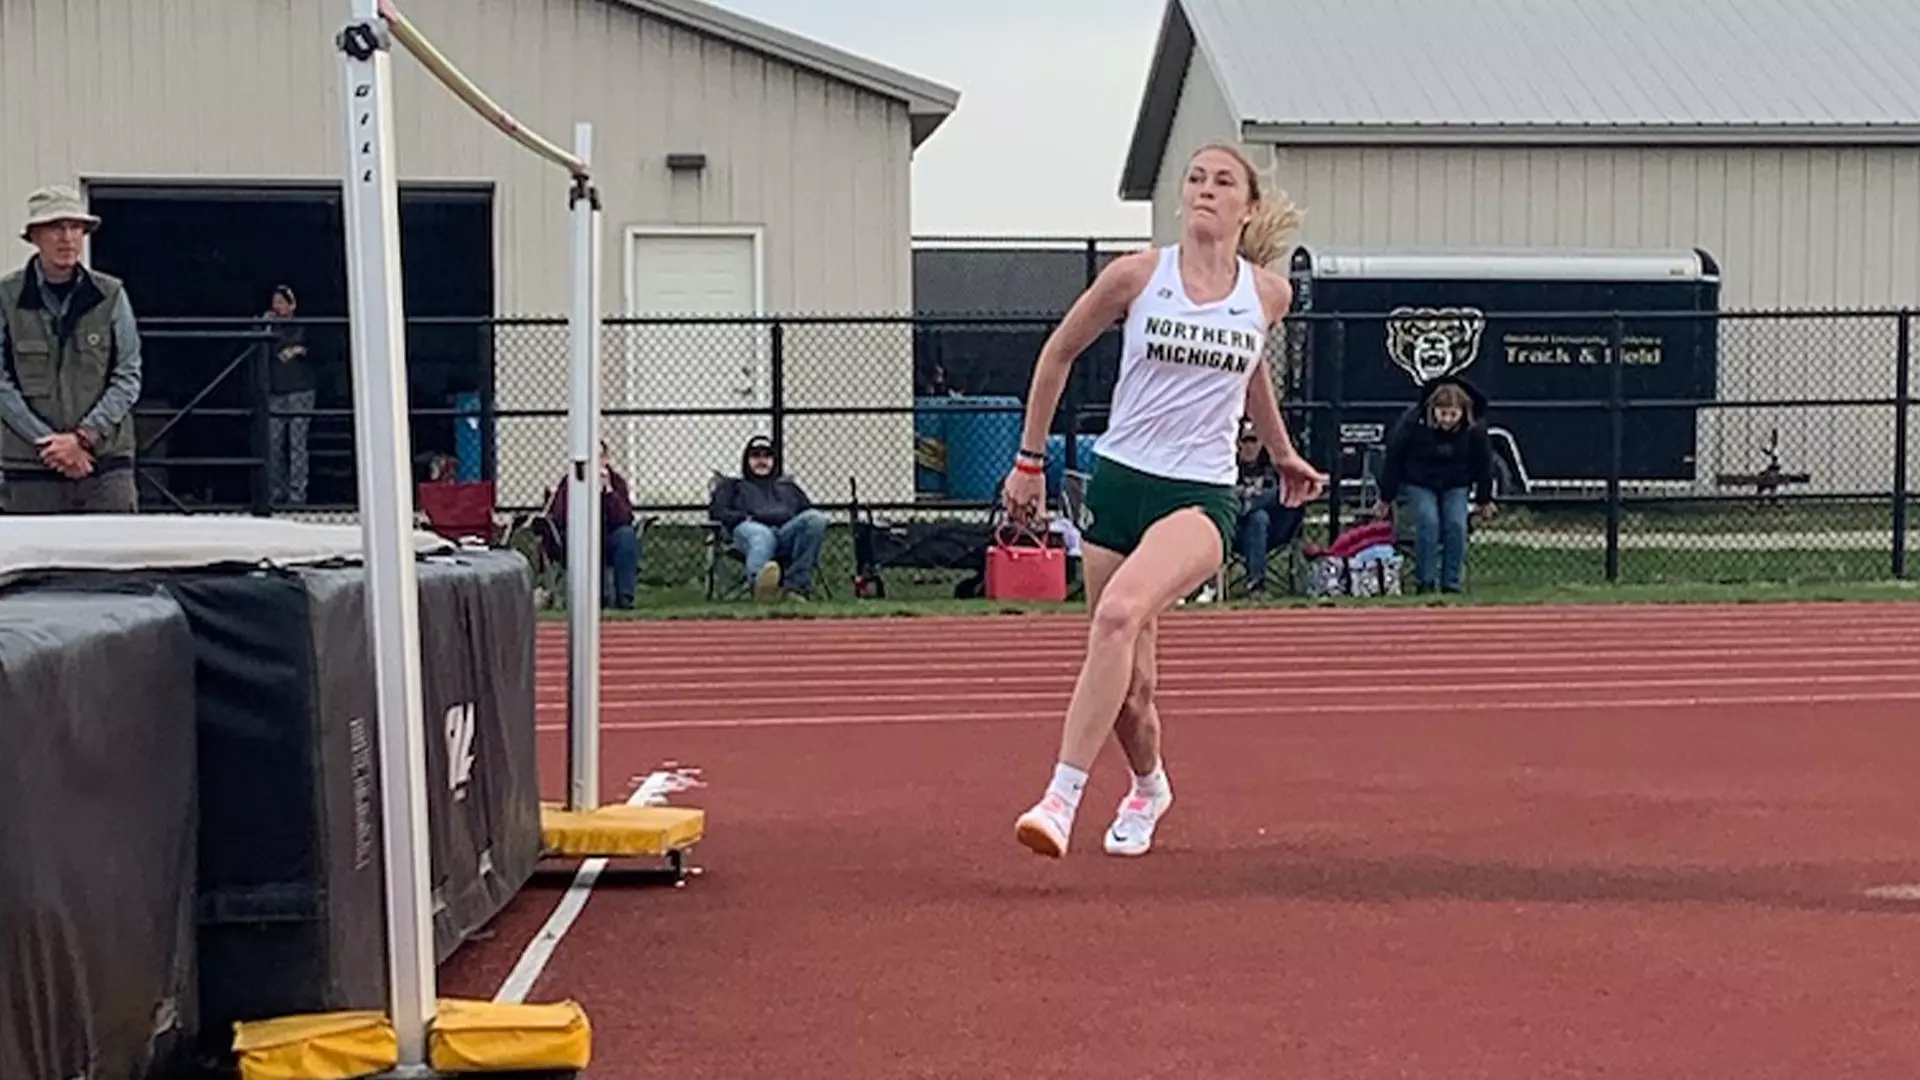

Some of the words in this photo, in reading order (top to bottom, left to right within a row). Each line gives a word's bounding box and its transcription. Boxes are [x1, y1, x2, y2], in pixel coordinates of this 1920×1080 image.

[355, 84, 372, 182] GILL
[1144, 316, 1257, 352] NORTHERN
[1146, 341, 1251, 374] MICHIGAN
[1504, 346, 1571, 364] Track
[1578, 347, 1598, 364] &
